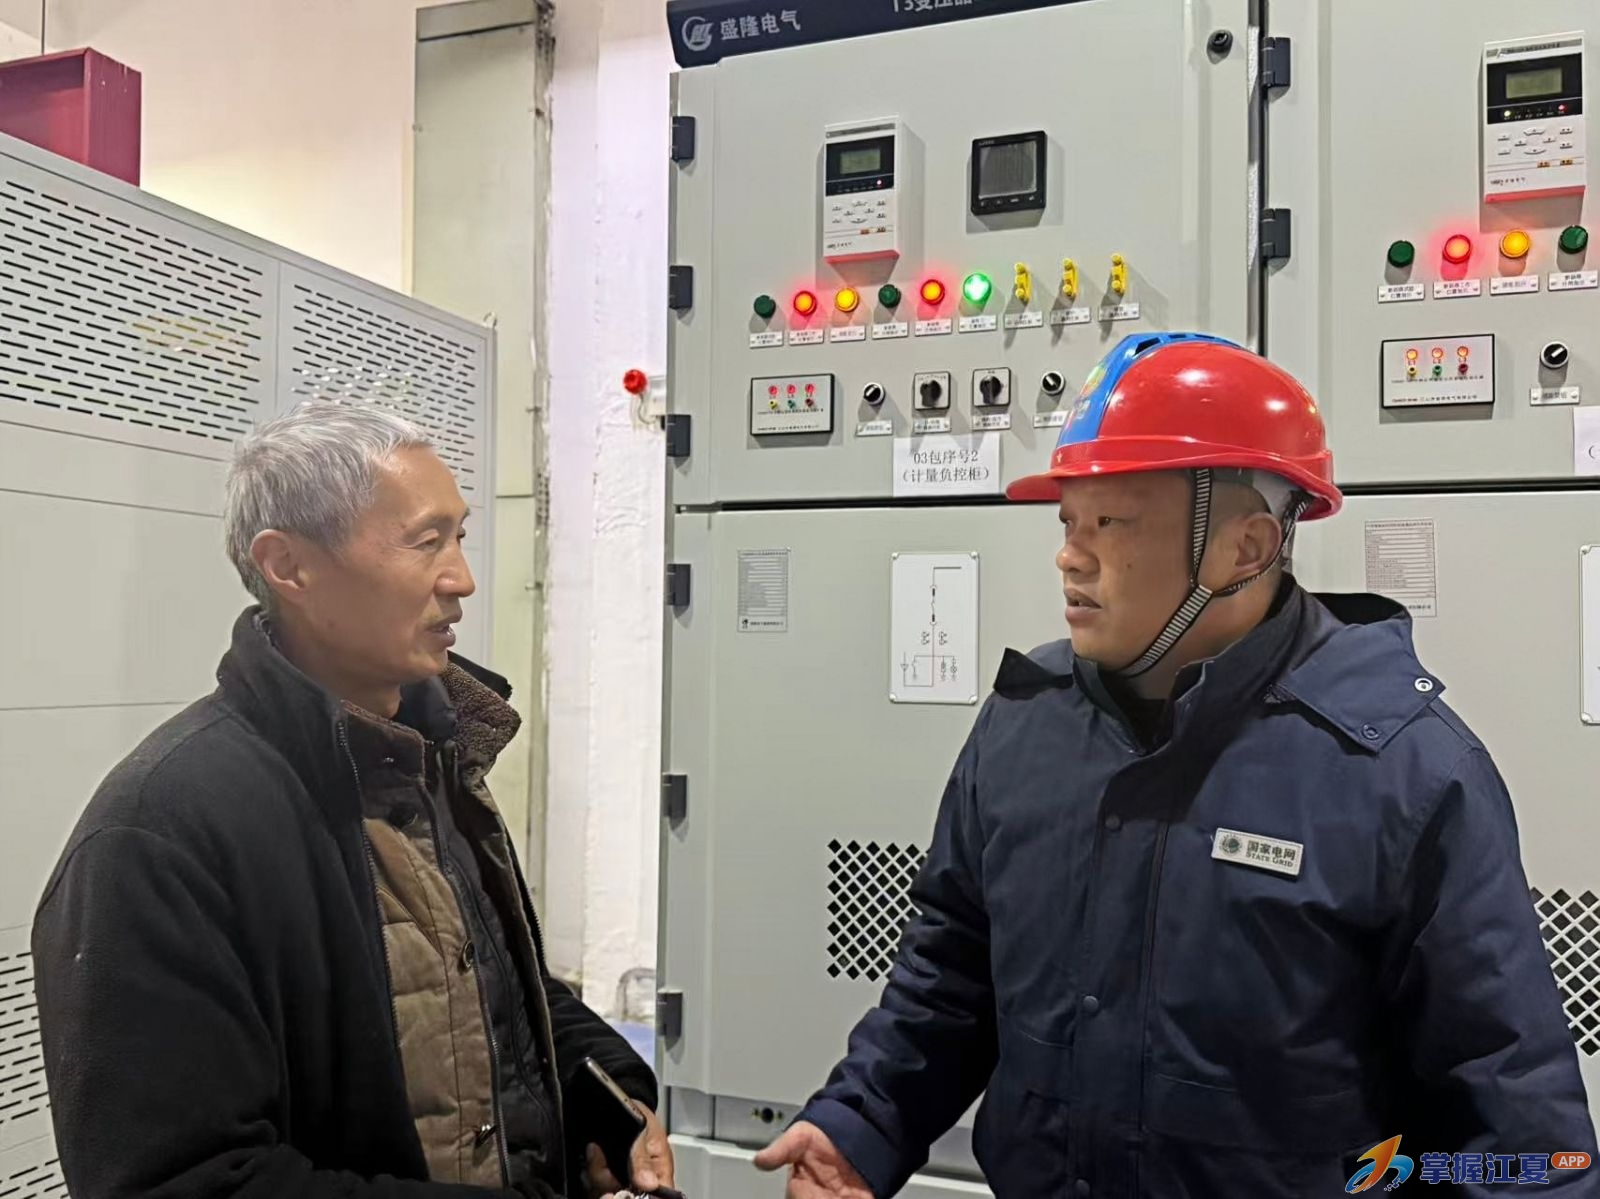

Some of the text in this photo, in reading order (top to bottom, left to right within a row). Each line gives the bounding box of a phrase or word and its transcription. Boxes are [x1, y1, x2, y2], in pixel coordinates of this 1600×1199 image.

[721, 10, 801, 40] 盛隆电气
[913, 449, 979, 465] 03包序号2
[1246, 851, 1294, 868] STATE GRID
[1247, 839, 1297, 861] 国家电网
